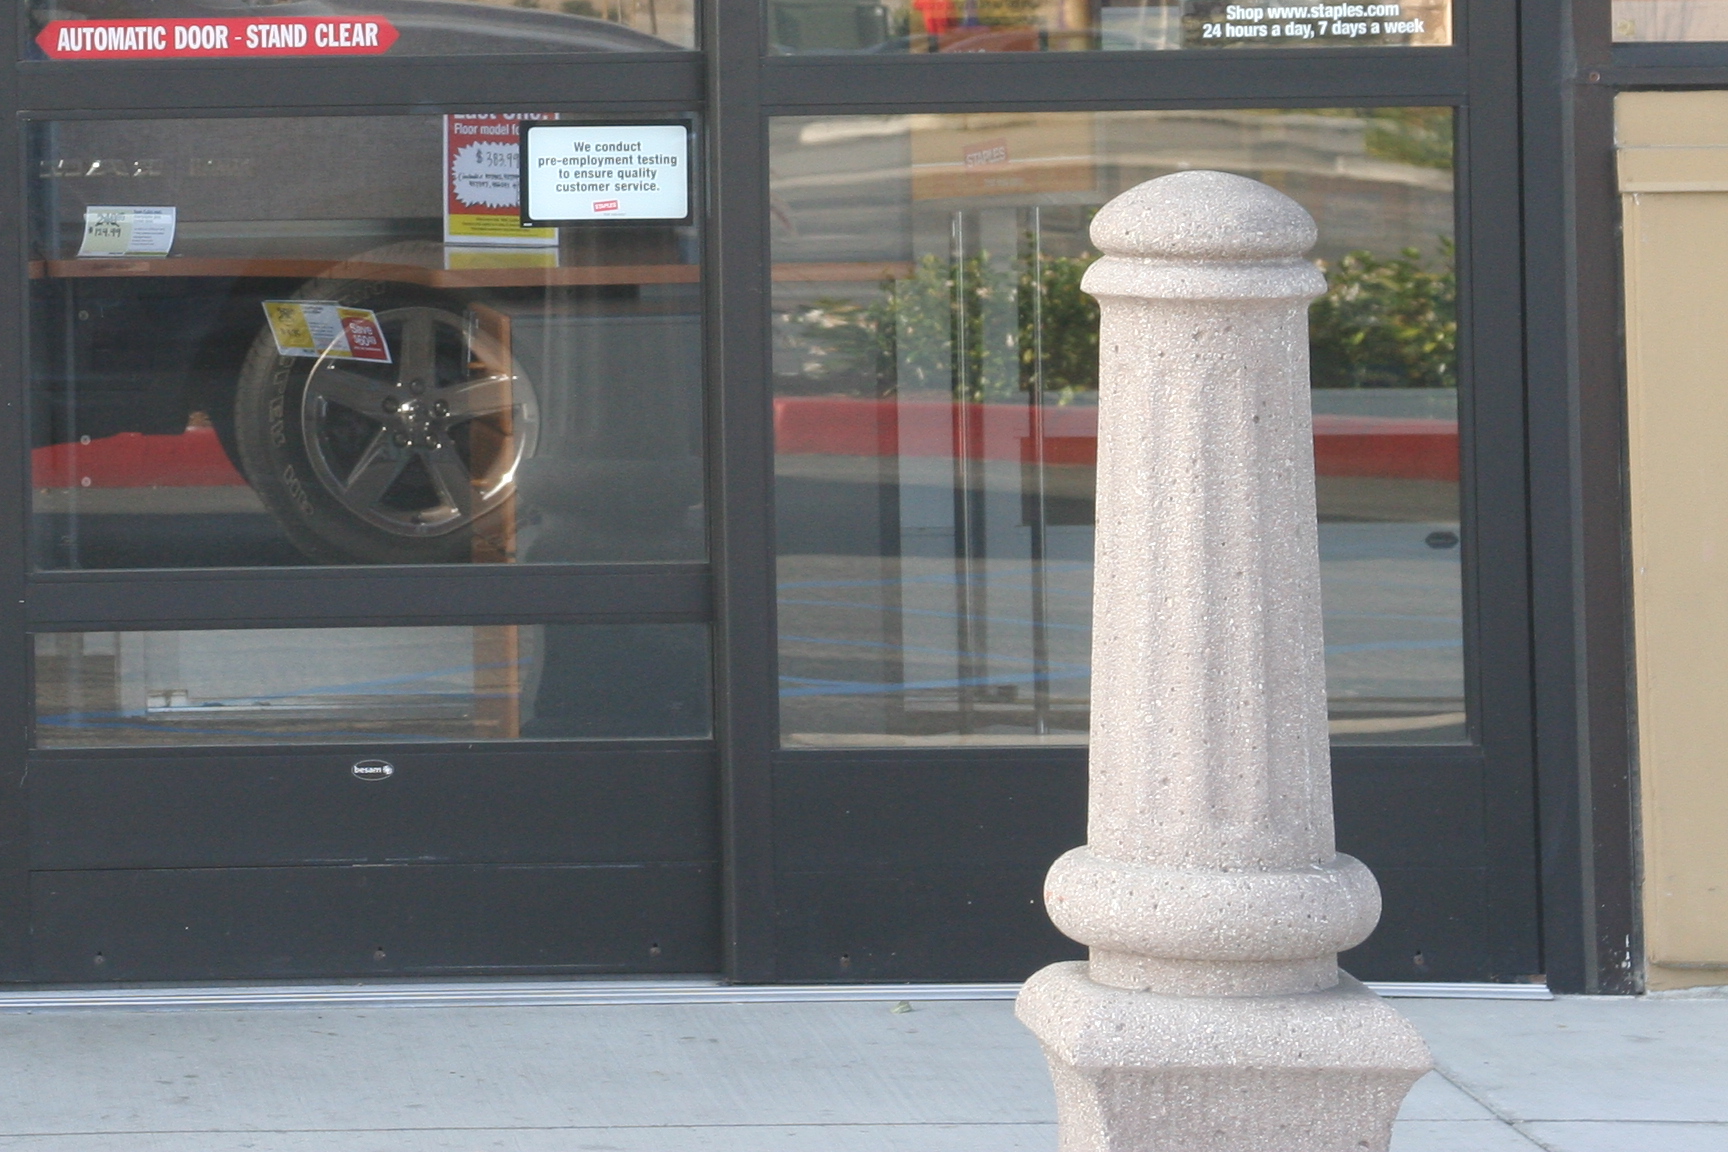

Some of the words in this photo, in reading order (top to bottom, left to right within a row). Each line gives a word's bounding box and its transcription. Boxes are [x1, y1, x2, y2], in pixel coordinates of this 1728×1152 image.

[1226, 5, 1263, 22] Shop
[1267, 2, 1399, 20] www.staples.com
[1203, 24, 1221, 38] 24
[1226, 22, 1267, 38] hours
[1272, 25, 1281, 36] a
[1286, 21, 1315, 38] day,
[1319, 21, 1327, 35] 7
[1332, 20, 1366, 36] days
[1370, 23, 1380, 34] a
[1384, 19, 1424, 34] week
[57, 26, 167, 51] AUTOMATIC
[175, 25, 228, 50] DOOR
[246, 23, 307, 48] STAND
[315, 22, 379, 47] CLEAR
[454, 122, 477, 135] Floor
[480, 122, 509, 135] model
[510, 123, 519, 135] fo
[574, 142, 591, 152] We
[595, 141, 641, 152] conduct
[538, 155, 634, 168] pre-employment
[637, 154, 678, 167] testing
[558, 169, 571, 179] to
[574, 170, 613, 179] ensure
[617, 167, 657, 181] quality
[556, 182, 610, 193] customer
[615, 181, 660, 192] service.
